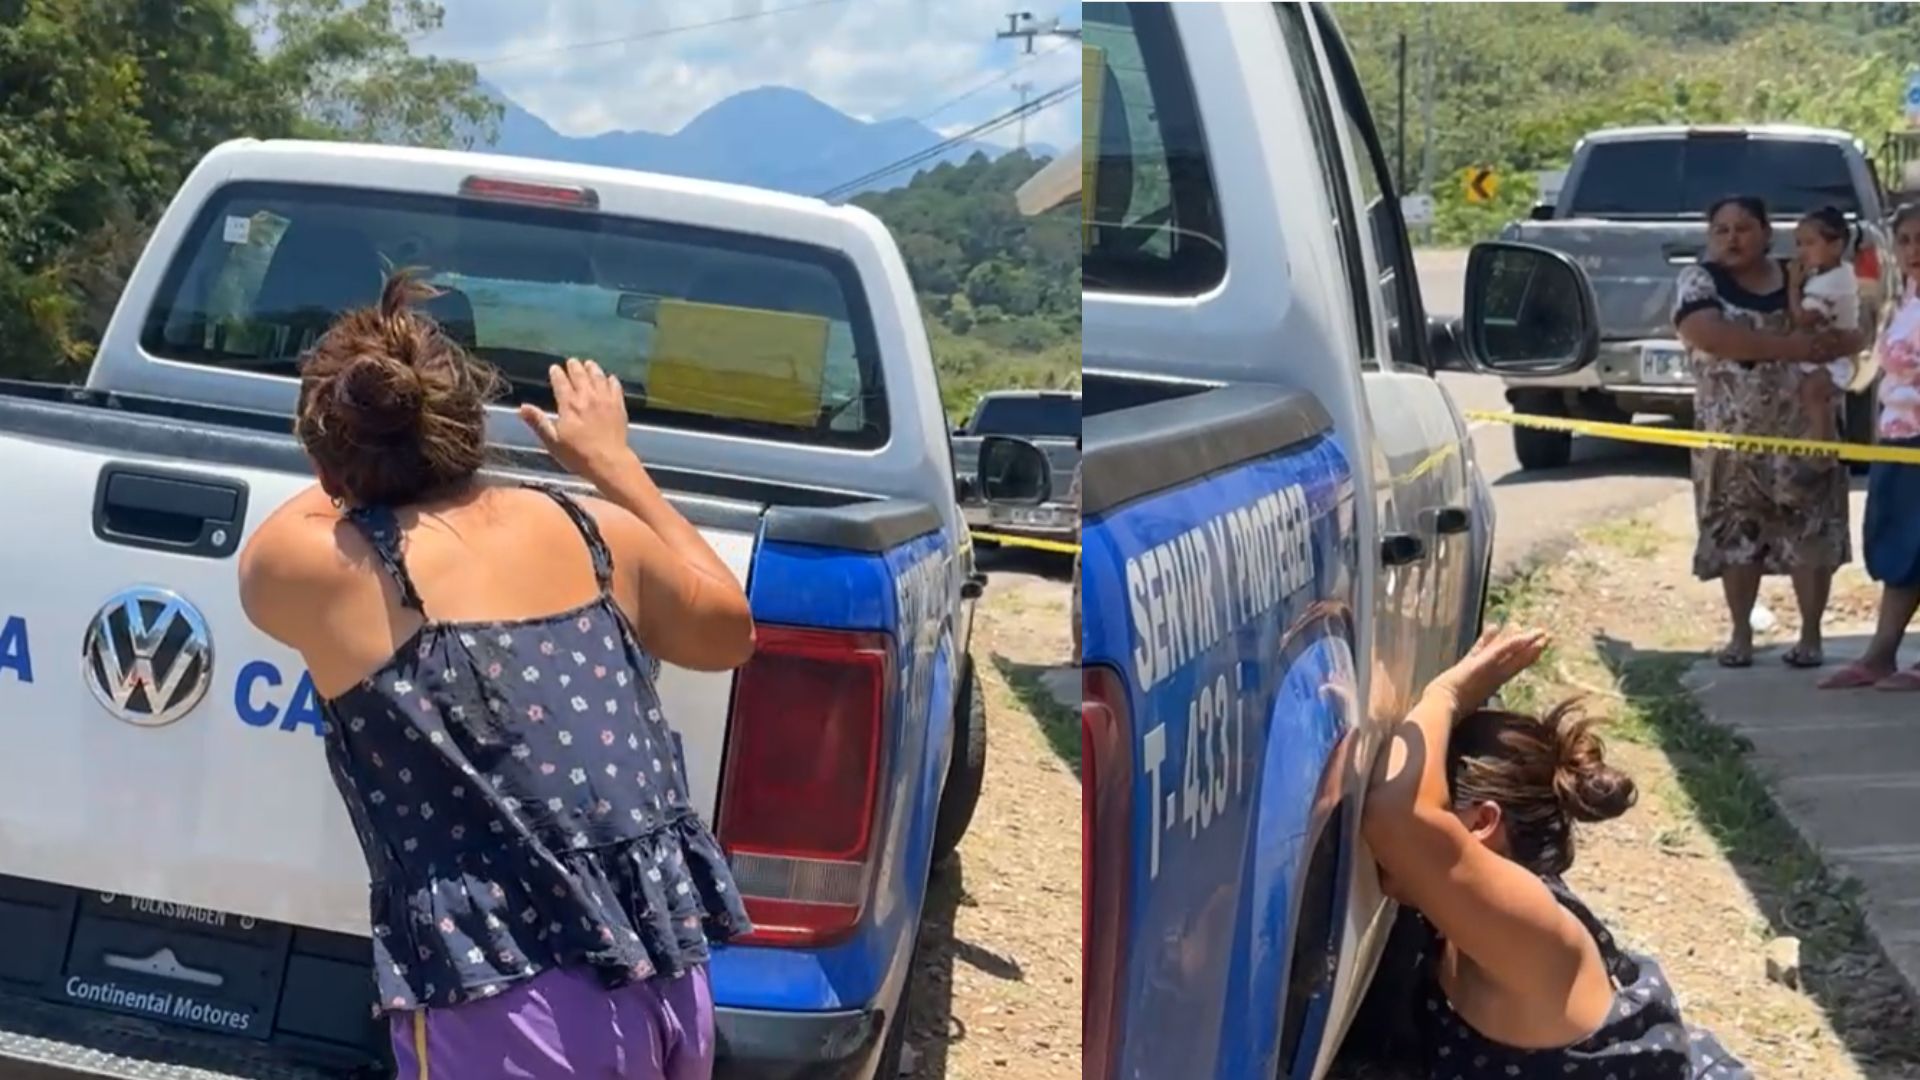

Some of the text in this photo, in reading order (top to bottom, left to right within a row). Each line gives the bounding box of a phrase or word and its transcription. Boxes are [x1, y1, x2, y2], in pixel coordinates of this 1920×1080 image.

[1126, 482, 1315, 692] SERVIR Y PROTEGER
[130, 895, 227, 928] VOLKSWAGEN
[66, 975, 250, 1030] Continental Motores
